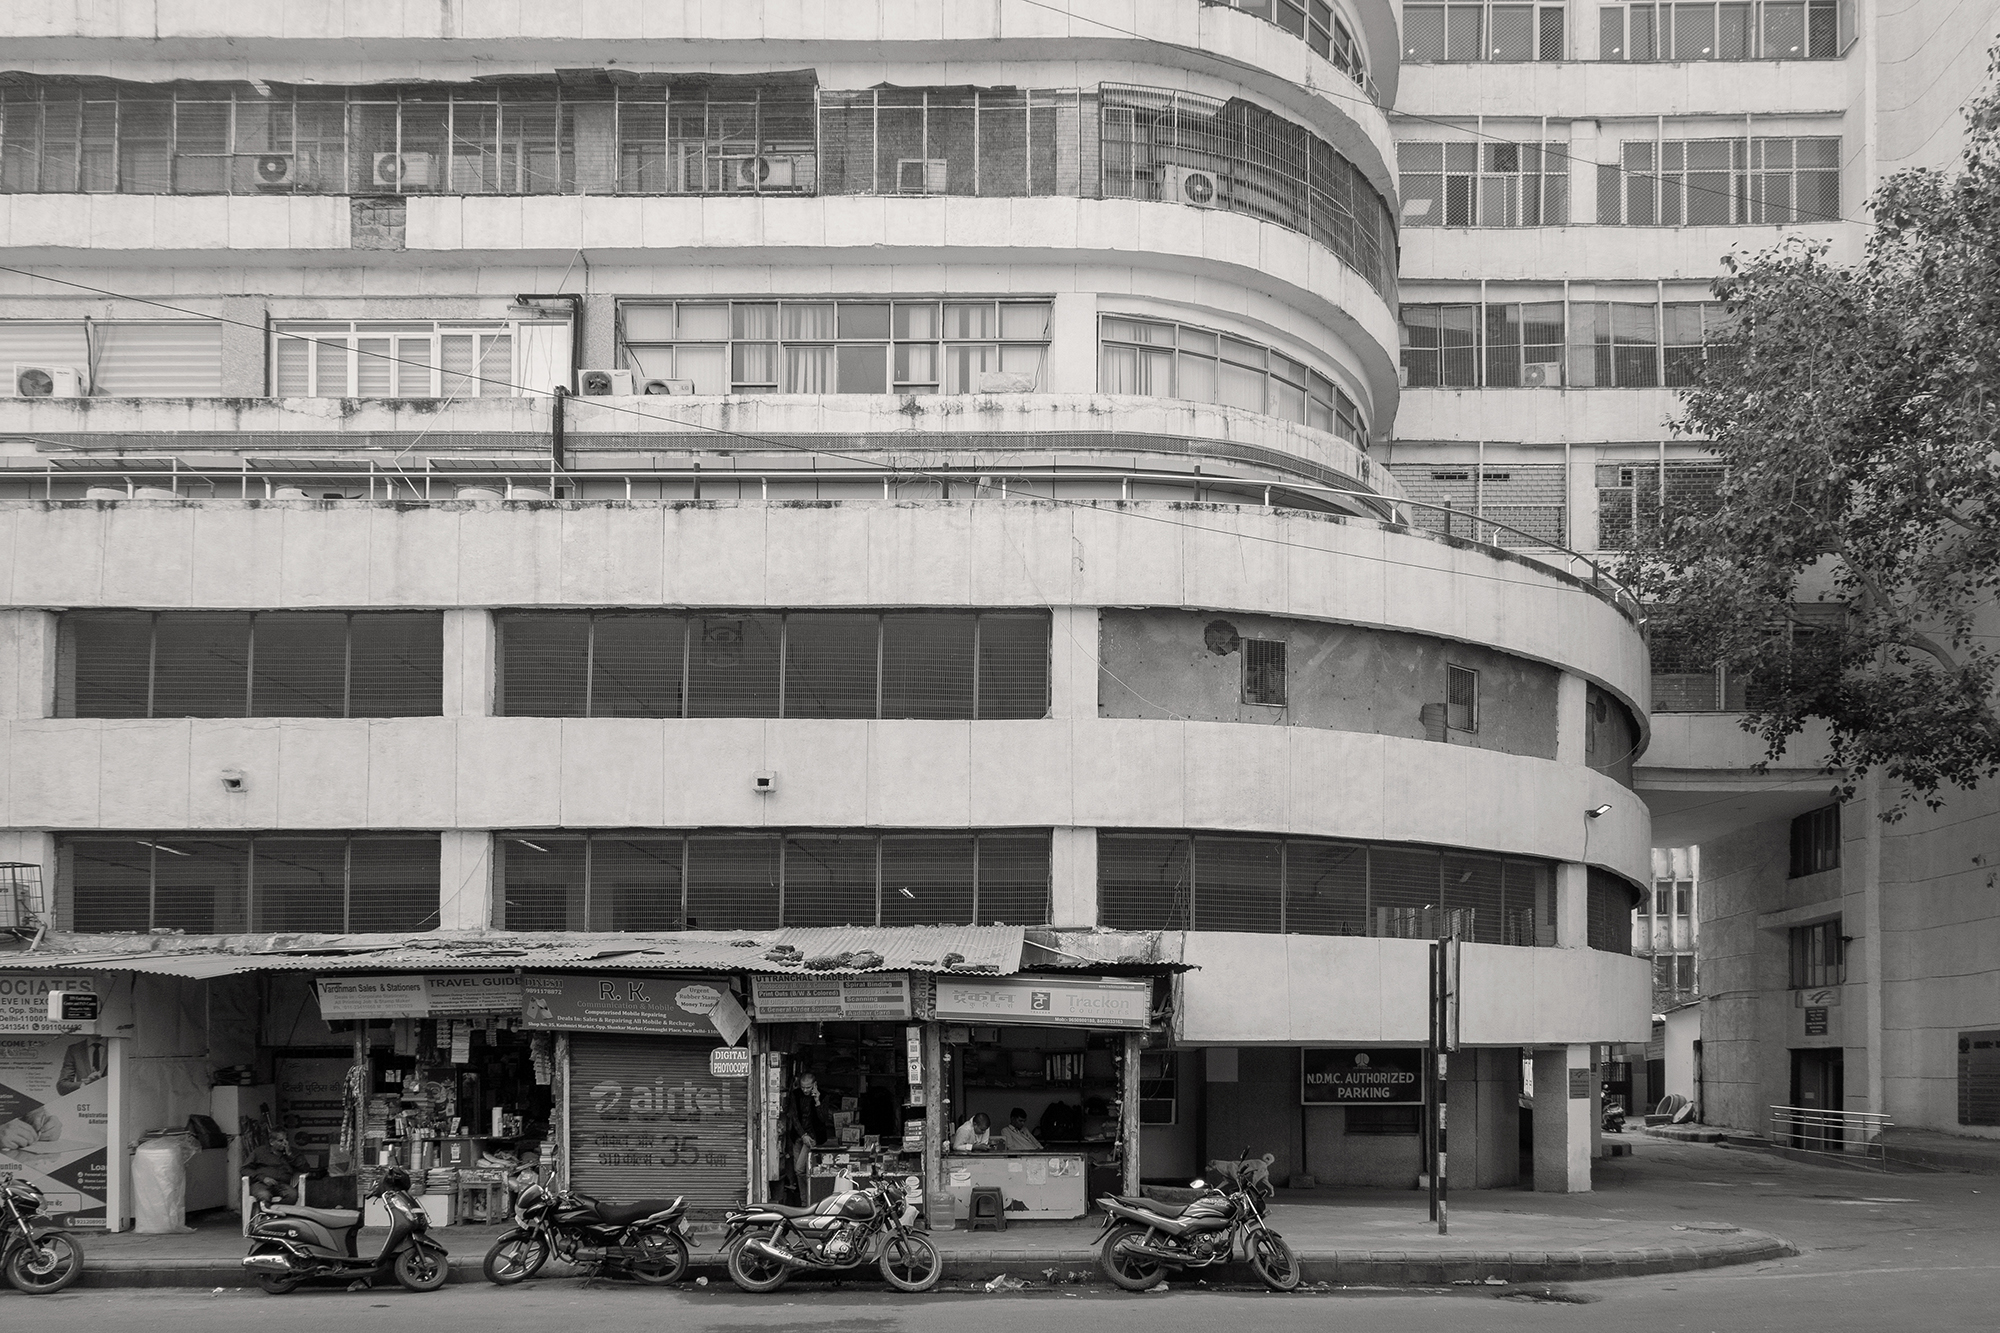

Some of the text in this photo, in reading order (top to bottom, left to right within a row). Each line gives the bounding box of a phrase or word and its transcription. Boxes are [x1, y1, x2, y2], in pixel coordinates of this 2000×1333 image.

[428, 978, 479, 987] TRAVEL
[525, 978, 564, 989] DINESH
[755, 974, 812, 983] UTTRANCHAL
[816, 973, 854, 981] TRADERS
[0, 980, 91, 995] OCIATES
[319, 982, 357, 993] Vardhman
[358, 984, 377, 992] Sales
[386, 983, 421, 991] Stationers
[599, 980, 651, 1002] R. K.
[577, 1001, 675, 1011] Communication & Mobile
[1066, 994, 1129, 1008] Trackon
[585, 1009, 621, 1017] Computerised
[641, 1011, 667, 1019] Repairing
[1069, 1006, 1130, 1016] Couriers
[604, 1017, 632, 1025] Repairing
[715, 1051, 747, 1060] DIGITAL
[714, 1062, 749, 1073] PHOTOCOPY
[1307, 1072, 1415, 1084] N.D.M.C. AUTHORIZED
[305, 1081, 328, 1095] पुलिस
[1338, 1086, 1390, 1098] PARKING
[629, 1076, 736, 1114] airtel
[76, 1104, 90, 1112] GST
[660, 1134, 700, 1167] 35
[90, 1163, 107, 1171] Loa
